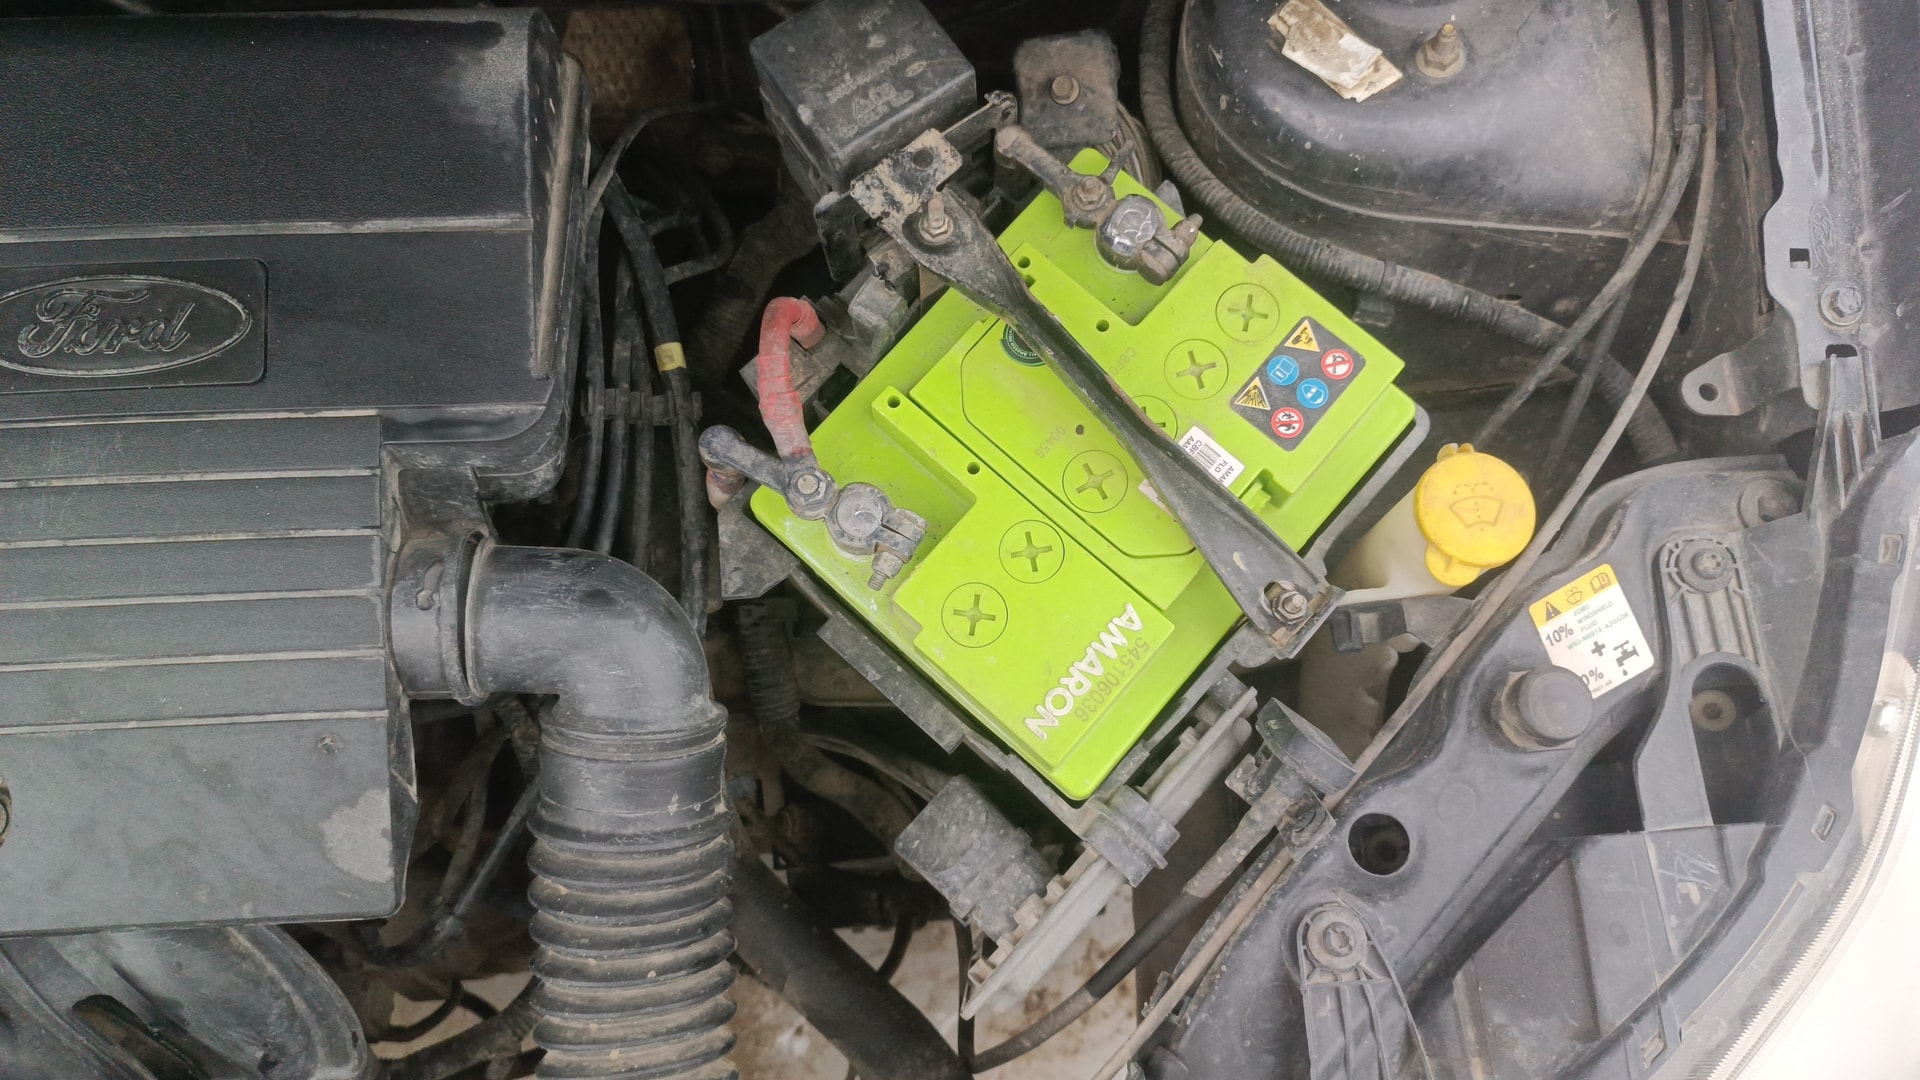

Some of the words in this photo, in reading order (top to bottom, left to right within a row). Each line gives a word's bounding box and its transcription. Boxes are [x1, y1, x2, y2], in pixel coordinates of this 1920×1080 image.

[18, 287, 195, 357] Ford
[1545, 623, 1574, 646] 10%
[1024, 602, 1142, 740] AMARON
[1074, 637, 1150, 722] 545106036
[1580, 666, 1604, 686] 0%
